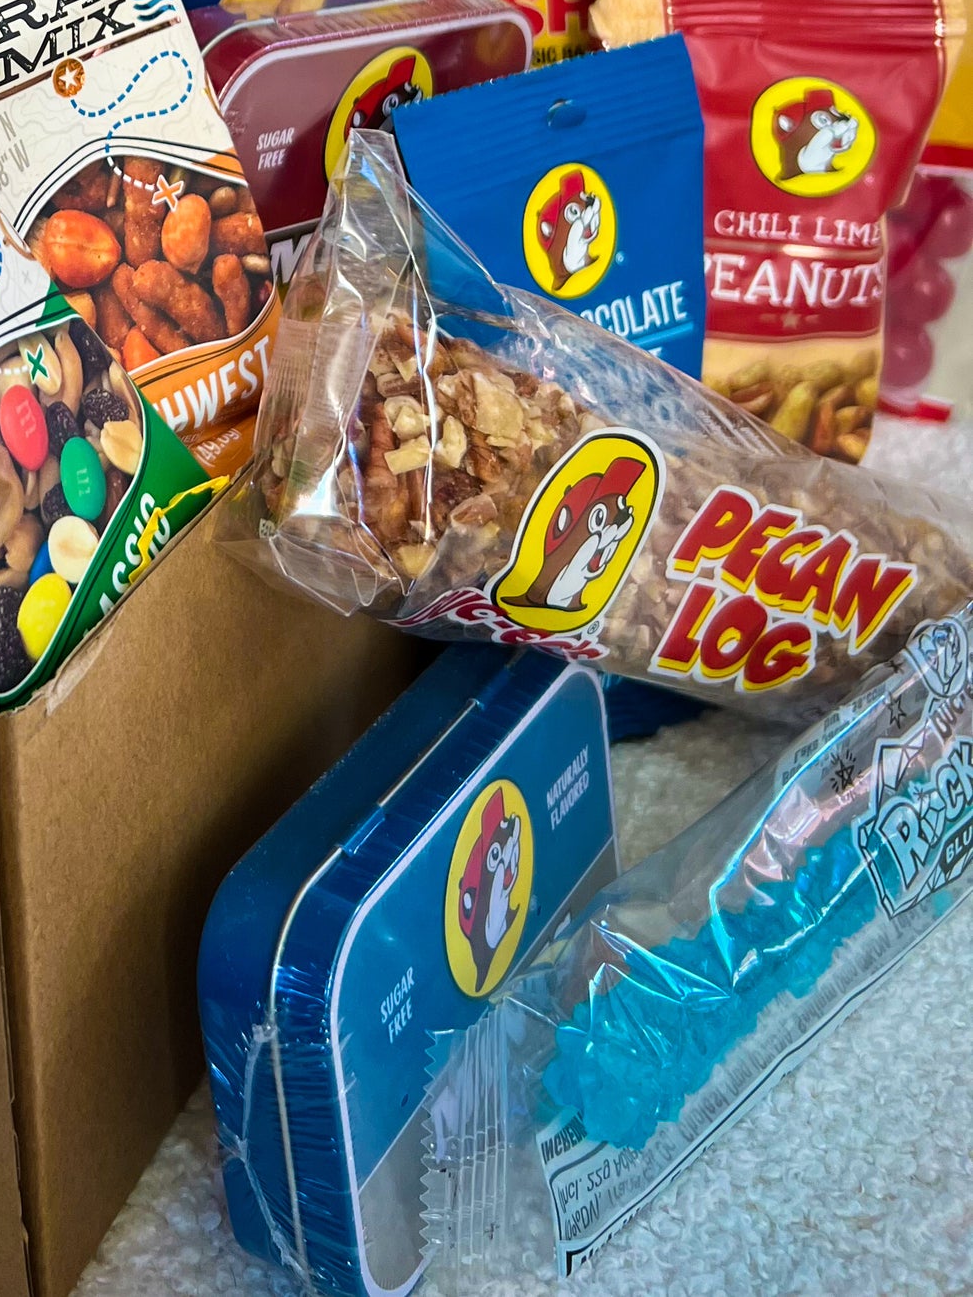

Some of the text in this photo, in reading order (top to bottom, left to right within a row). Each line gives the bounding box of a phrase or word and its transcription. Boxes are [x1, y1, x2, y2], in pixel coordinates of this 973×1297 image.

[256, 126, 296, 151] SUGAR
[257, 147, 287, 172] FREE
[713, 208, 802, 240] CHILI
[154, 334, 271, 435] HWEST
[667, 485, 917, 654] PECAN
[651, 577, 816, 692] LOG
[546, 743, 589, 811] NATURALLY
[550, 770, 590, 831] FLAVORED
[945, 824, 973, 867] BLU
[380, 965, 416, 1025] SUGAR
[387, 996, 414, 1044] FREE
